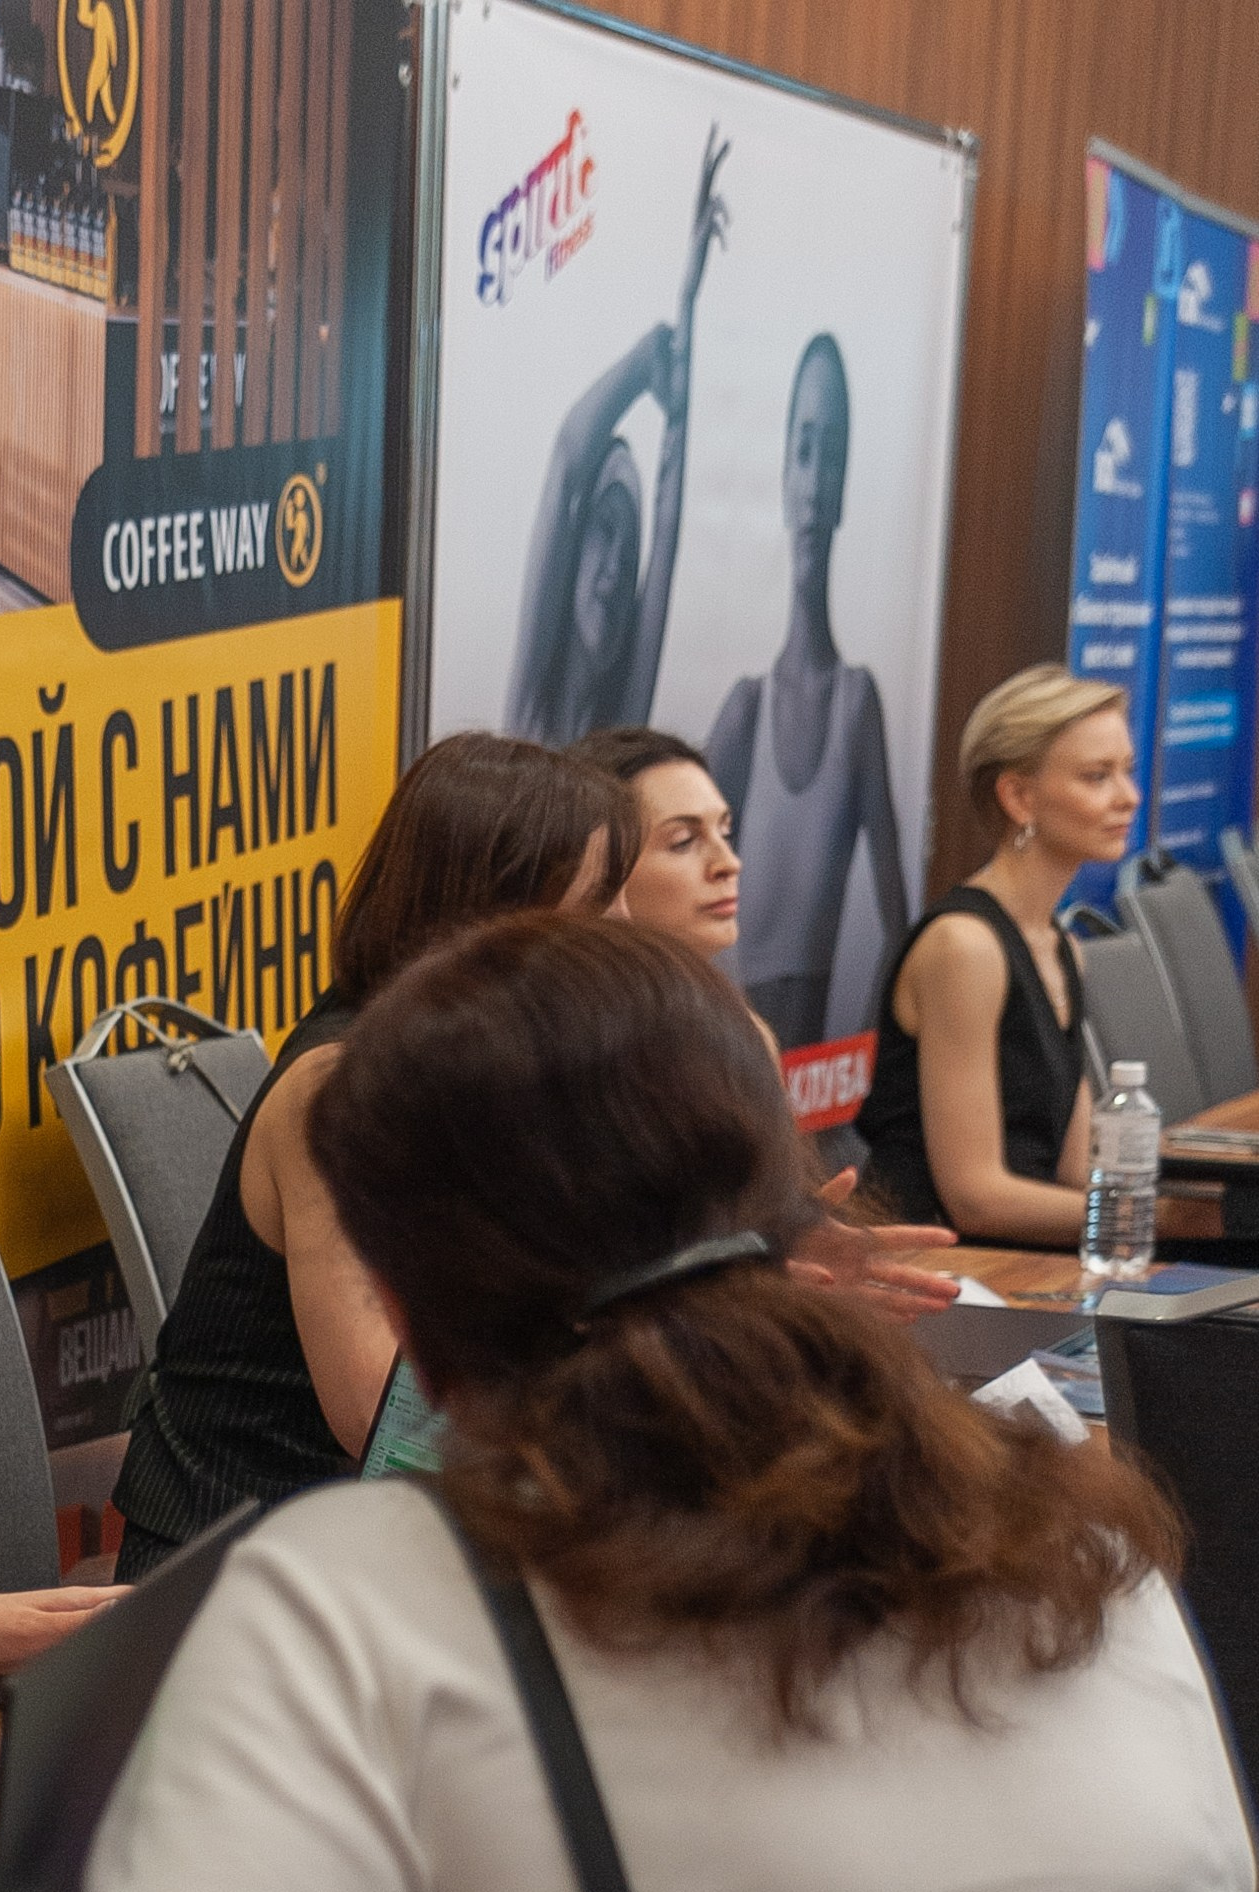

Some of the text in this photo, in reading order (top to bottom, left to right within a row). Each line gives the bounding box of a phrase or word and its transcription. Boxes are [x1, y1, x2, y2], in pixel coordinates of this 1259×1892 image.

[102, 501, 271, 593] COFFEE WAY
[100, 708, 141, 894] С
[161, 661, 338, 878] НАМИ
